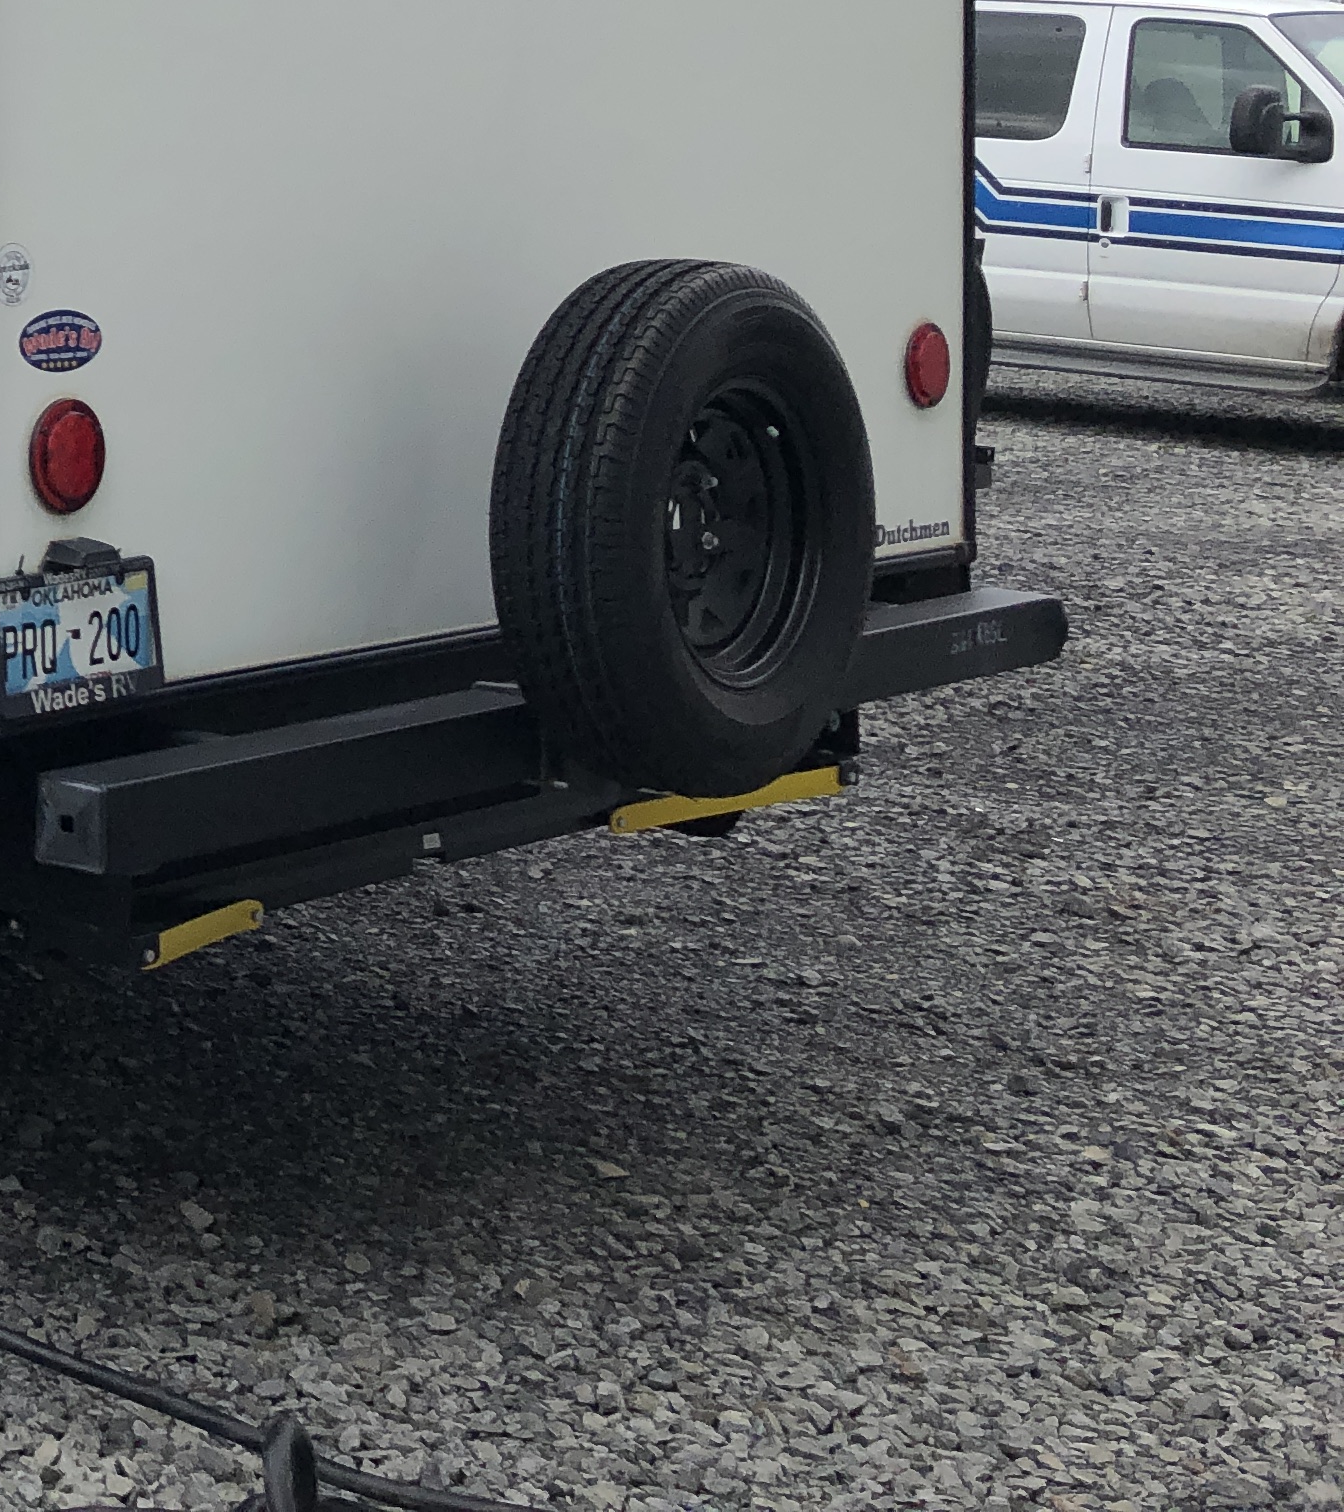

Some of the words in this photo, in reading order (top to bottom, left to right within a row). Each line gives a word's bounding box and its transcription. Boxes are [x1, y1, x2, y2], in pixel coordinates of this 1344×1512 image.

[874, 519, 950, 548] Dutchmen
[31, 578, 114, 607] OKLAHOMA
[2, 618, 57, 683] PRQ
[88, 603, 140, 666] 200
[30, 682, 107, 713] Wade's
